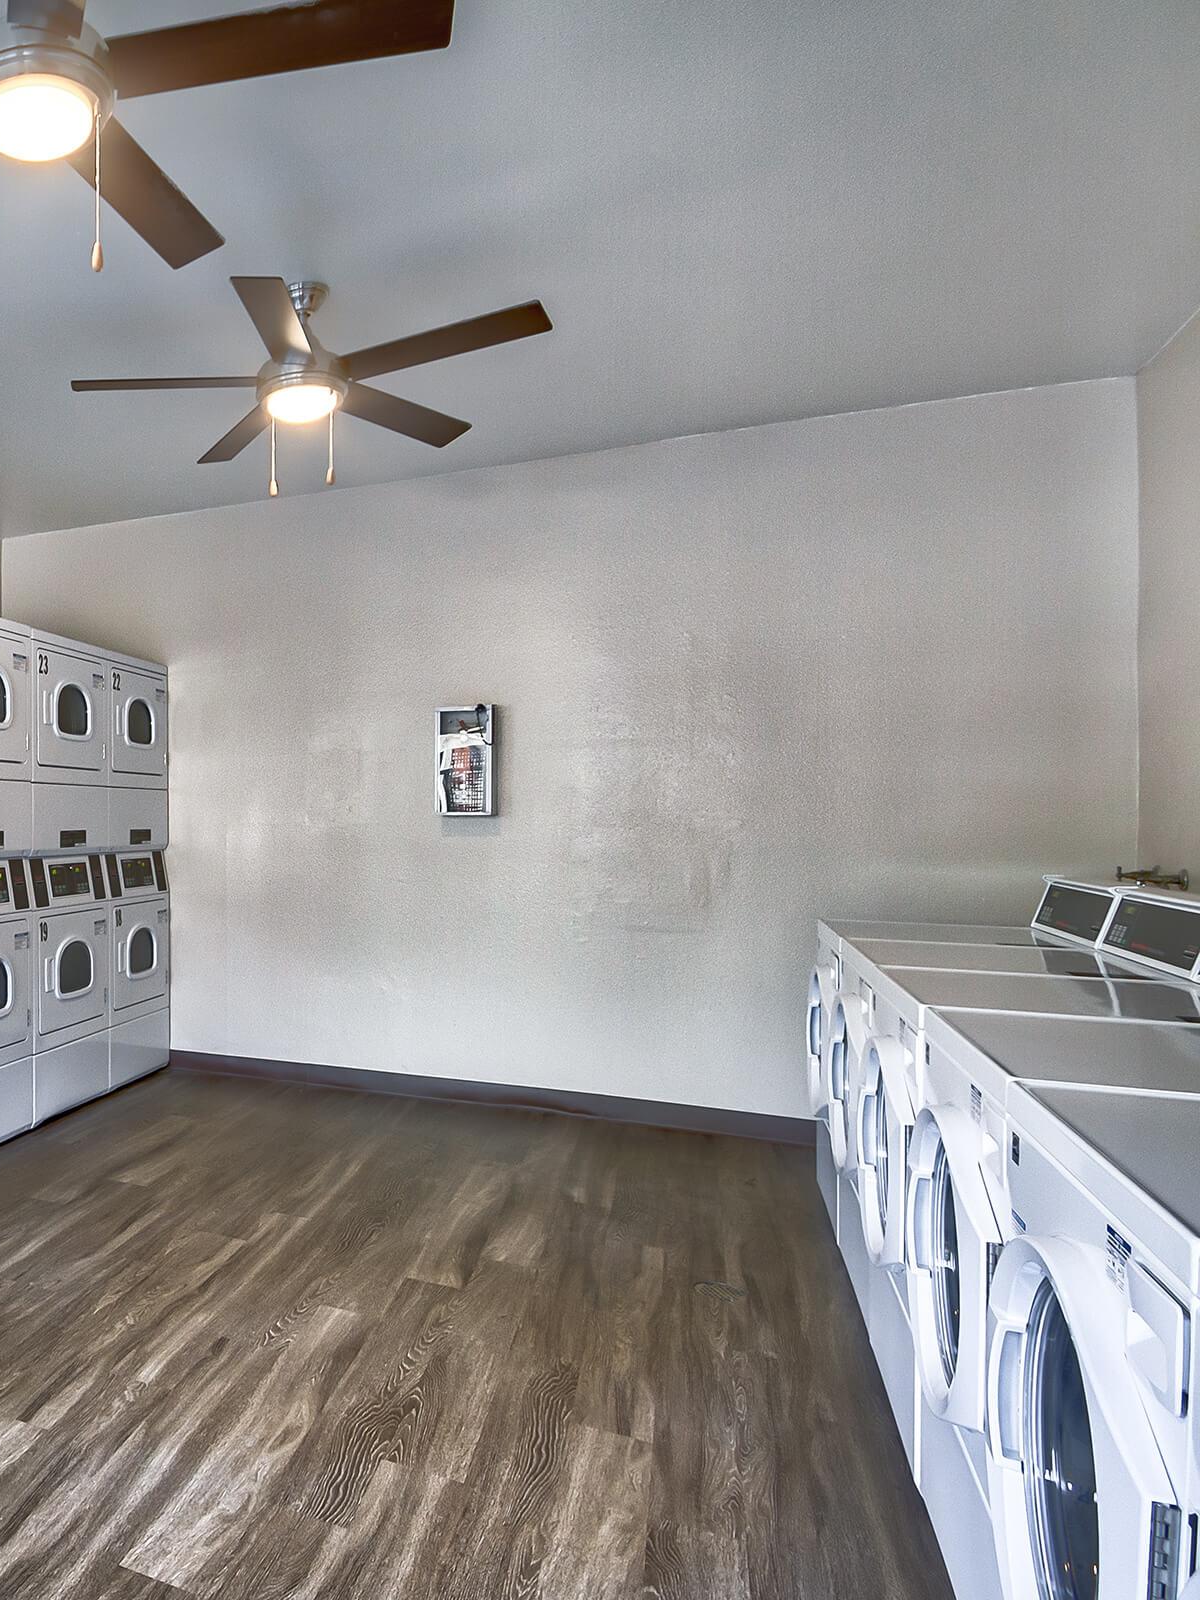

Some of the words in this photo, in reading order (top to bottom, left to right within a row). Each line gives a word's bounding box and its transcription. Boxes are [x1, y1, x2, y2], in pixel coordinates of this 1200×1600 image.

[38, 653, 49, 675] 23
[112, 671, 121, 691] 22
[39, 921, 48, 942] 19
